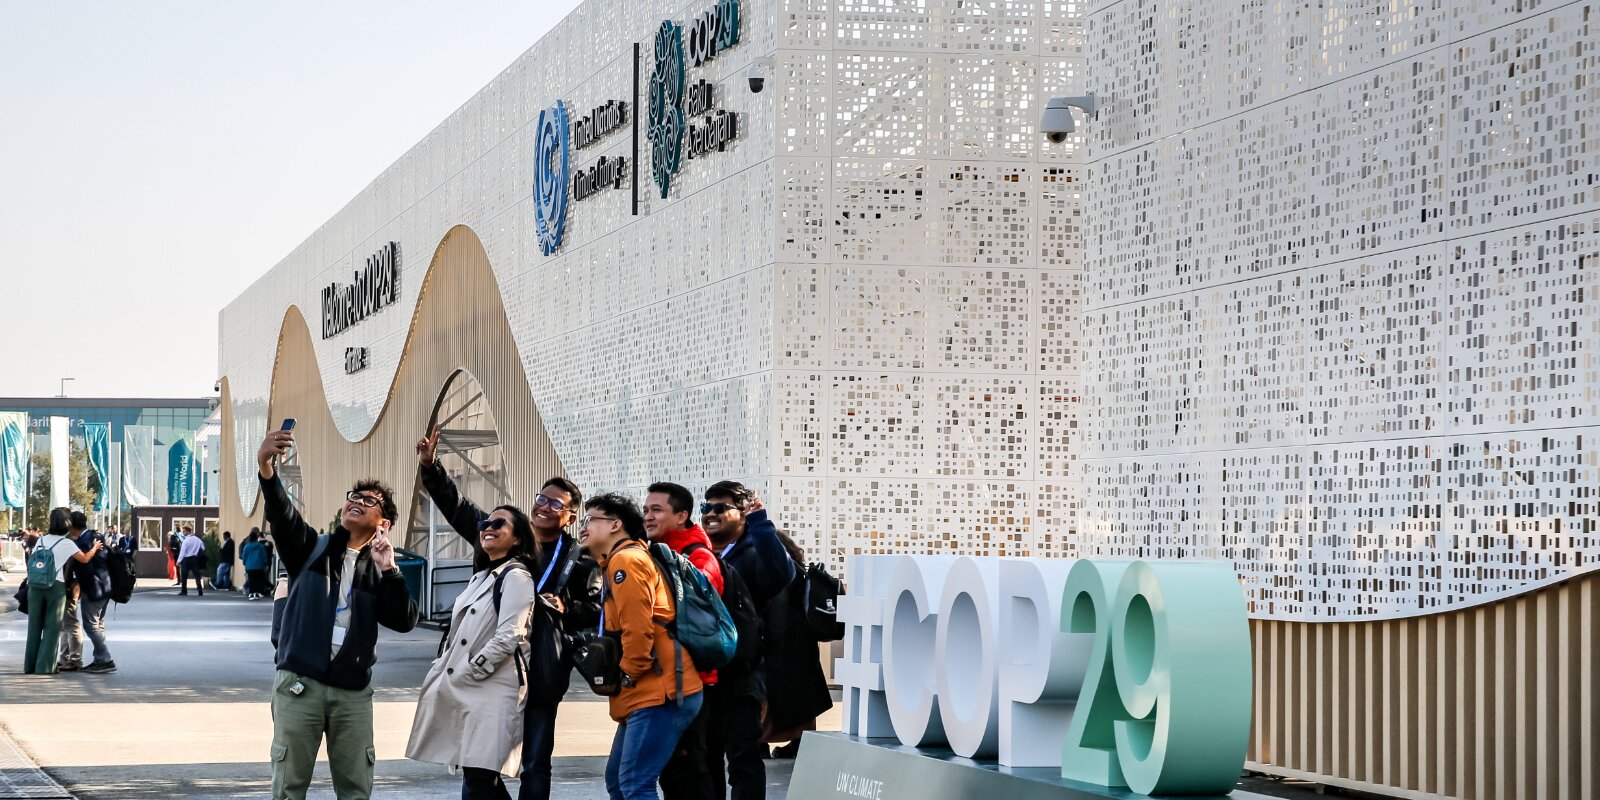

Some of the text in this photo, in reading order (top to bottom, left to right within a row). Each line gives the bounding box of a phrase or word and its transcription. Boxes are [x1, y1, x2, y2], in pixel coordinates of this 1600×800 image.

[688, 0, 736, 67] COP29
[688, 79, 711, 117] Baku
[574, 100, 622, 150] United Nations
[688, 110, 735, 159] Azerbaijan
[574, 156, 622, 201] Climate Change
[321, 283, 353, 340] Welcome
[362, 241, 394, 317] COP29
[179, 455, 188, 480] World
[835, 555, 1251, 797] #COP29
[836, 771, 884, 800] UN CLIMATE
